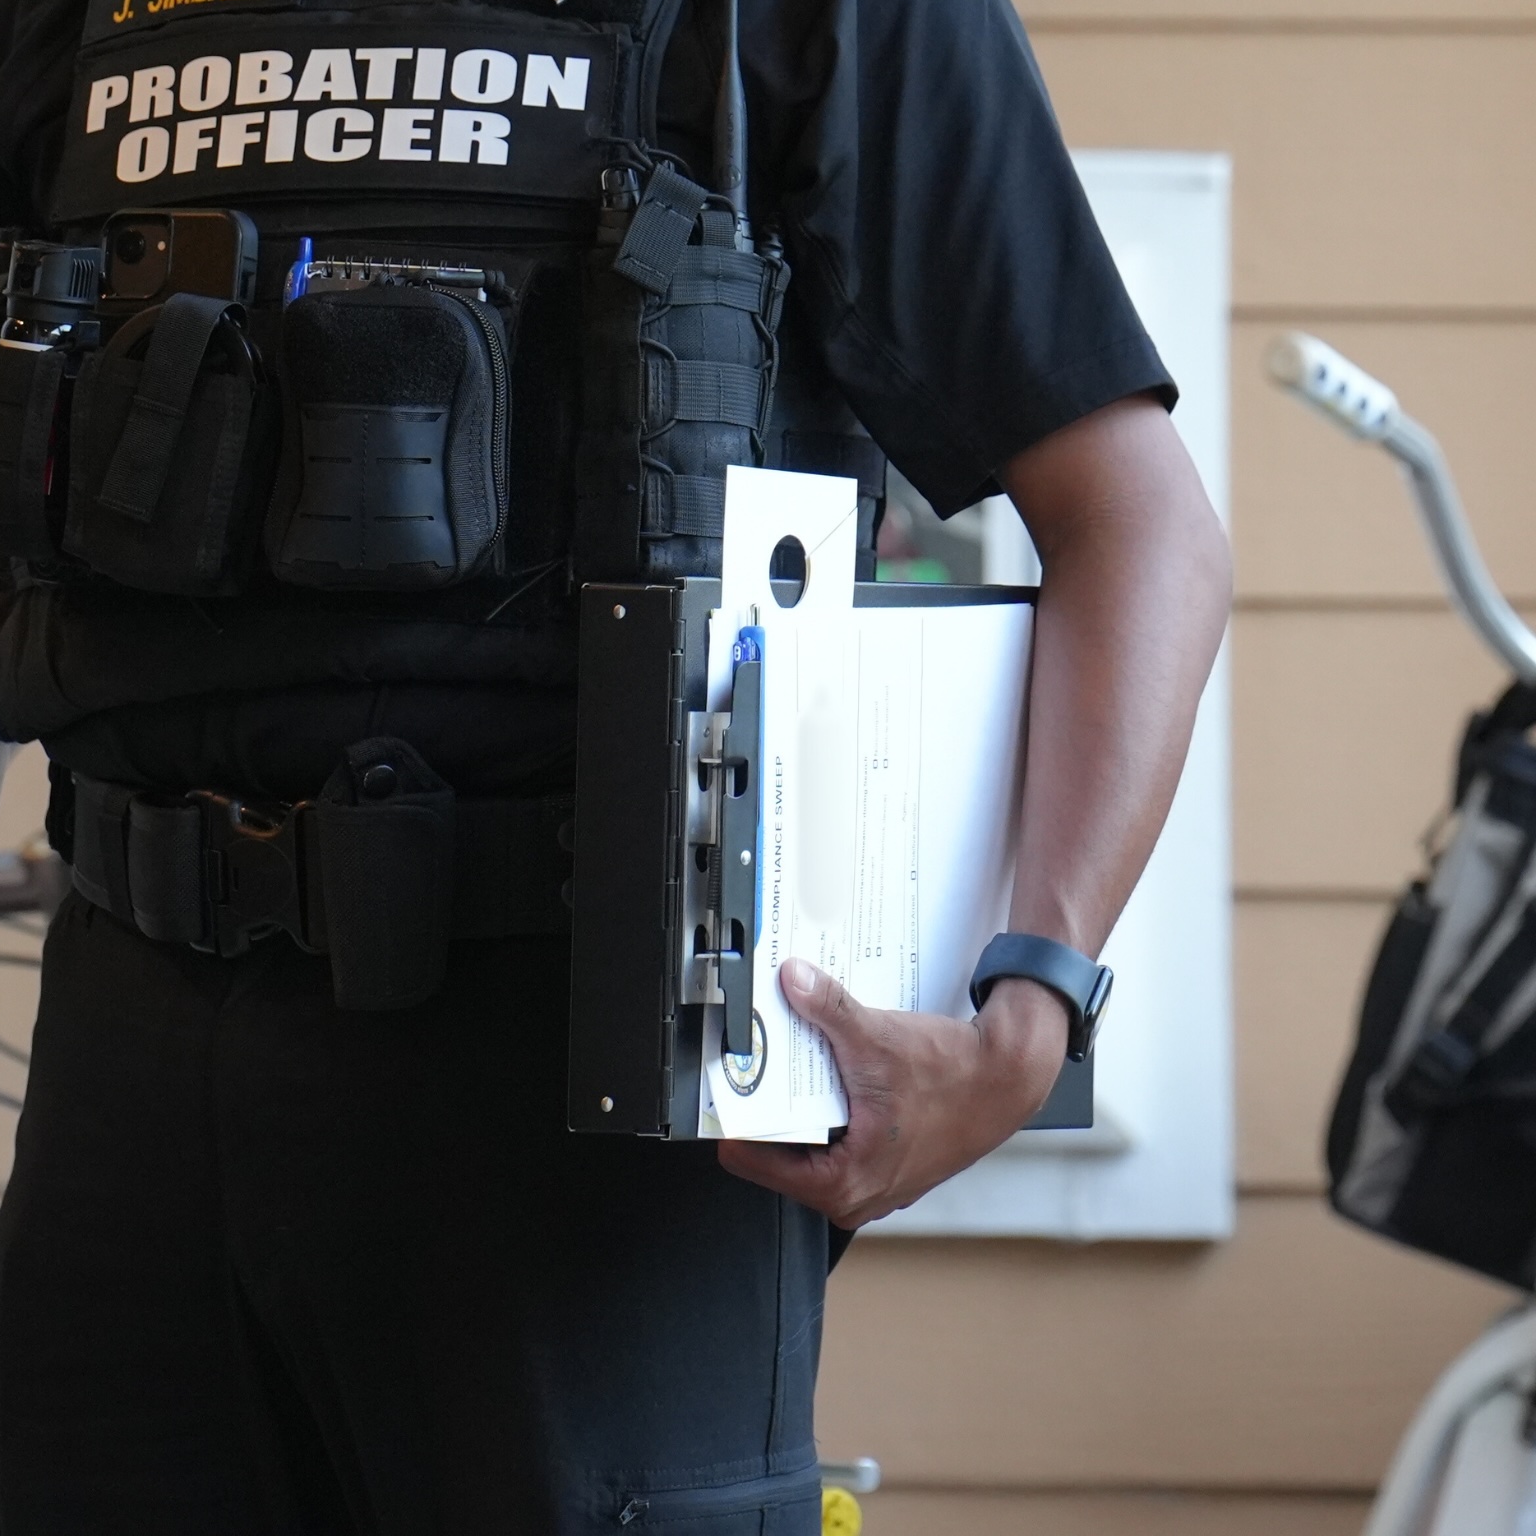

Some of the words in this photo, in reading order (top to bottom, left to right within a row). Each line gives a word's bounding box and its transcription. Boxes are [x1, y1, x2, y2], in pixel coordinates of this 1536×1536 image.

[86, 47, 591, 134] PROBATION
[116, 107, 511, 182] OFFICER
[774, 755, 783, 816] SWEEP
[771, 821, 783, 934] COMPLIANCE
[770, 939, 779, 969] DUI
